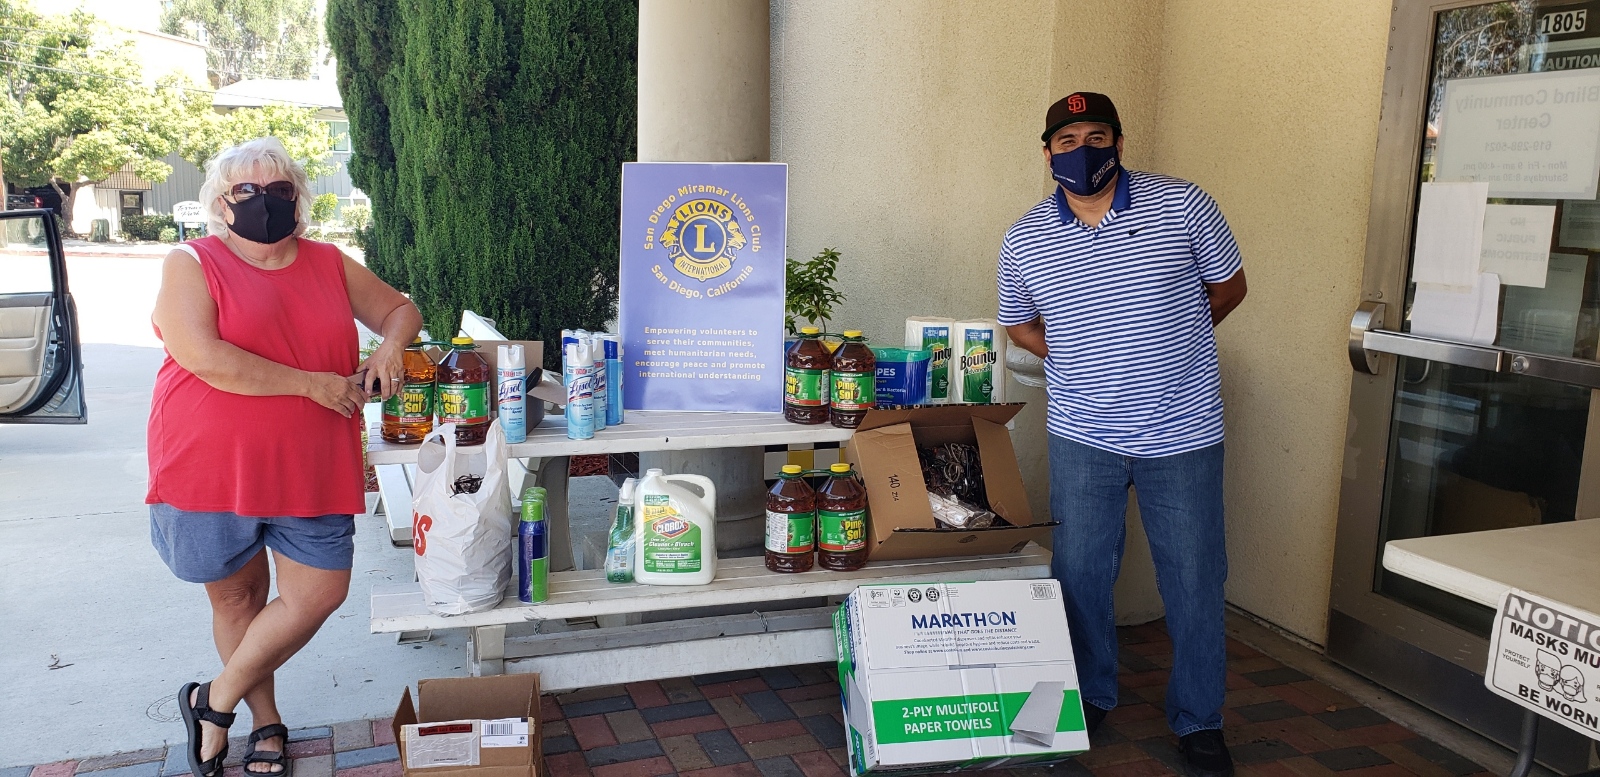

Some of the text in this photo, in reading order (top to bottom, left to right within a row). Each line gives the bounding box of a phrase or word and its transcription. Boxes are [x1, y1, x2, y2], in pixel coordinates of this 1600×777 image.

[1542, 11, 1585, 34] 1805
[679, 202, 728, 219] LIONS
[644, 185, 761, 252] San Diego Miramar Lions Club
[694, 224, 715, 252] L
[678, 260, 727, 275] INTERNATIONAL
[652, 264, 753, 299] San Diego, California
[644, 327, 697, 335] Empowering
[960, 350, 997, 370] Bounty
[699, 372, 761, 381] understanding
[499, 381, 522, 398] Lysol
[840, 390, 854, 400] Sol
[404, 402, 422, 413] Sol
[444, 402, 460, 414] Sol
[888, 474, 900, 488] 140
[656, 521, 685, 534] CLOROX
[847, 530, 861, 540] Sol
[911, 611, 1016, 629] MARATHON
[1507, 596, 1600, 652] NOTIC
[1510, 622, 1600, 669] MASKS MU
[1502, 653, 1531, 668] YOURSELF
[1505, 649, 1530, 662] PROTECT
[902, 706, 932, 718] 2-PLY
[1518, 684, 1598, 729] BE WORN
[904, 718, 992, 734] PAPER TOWELS
